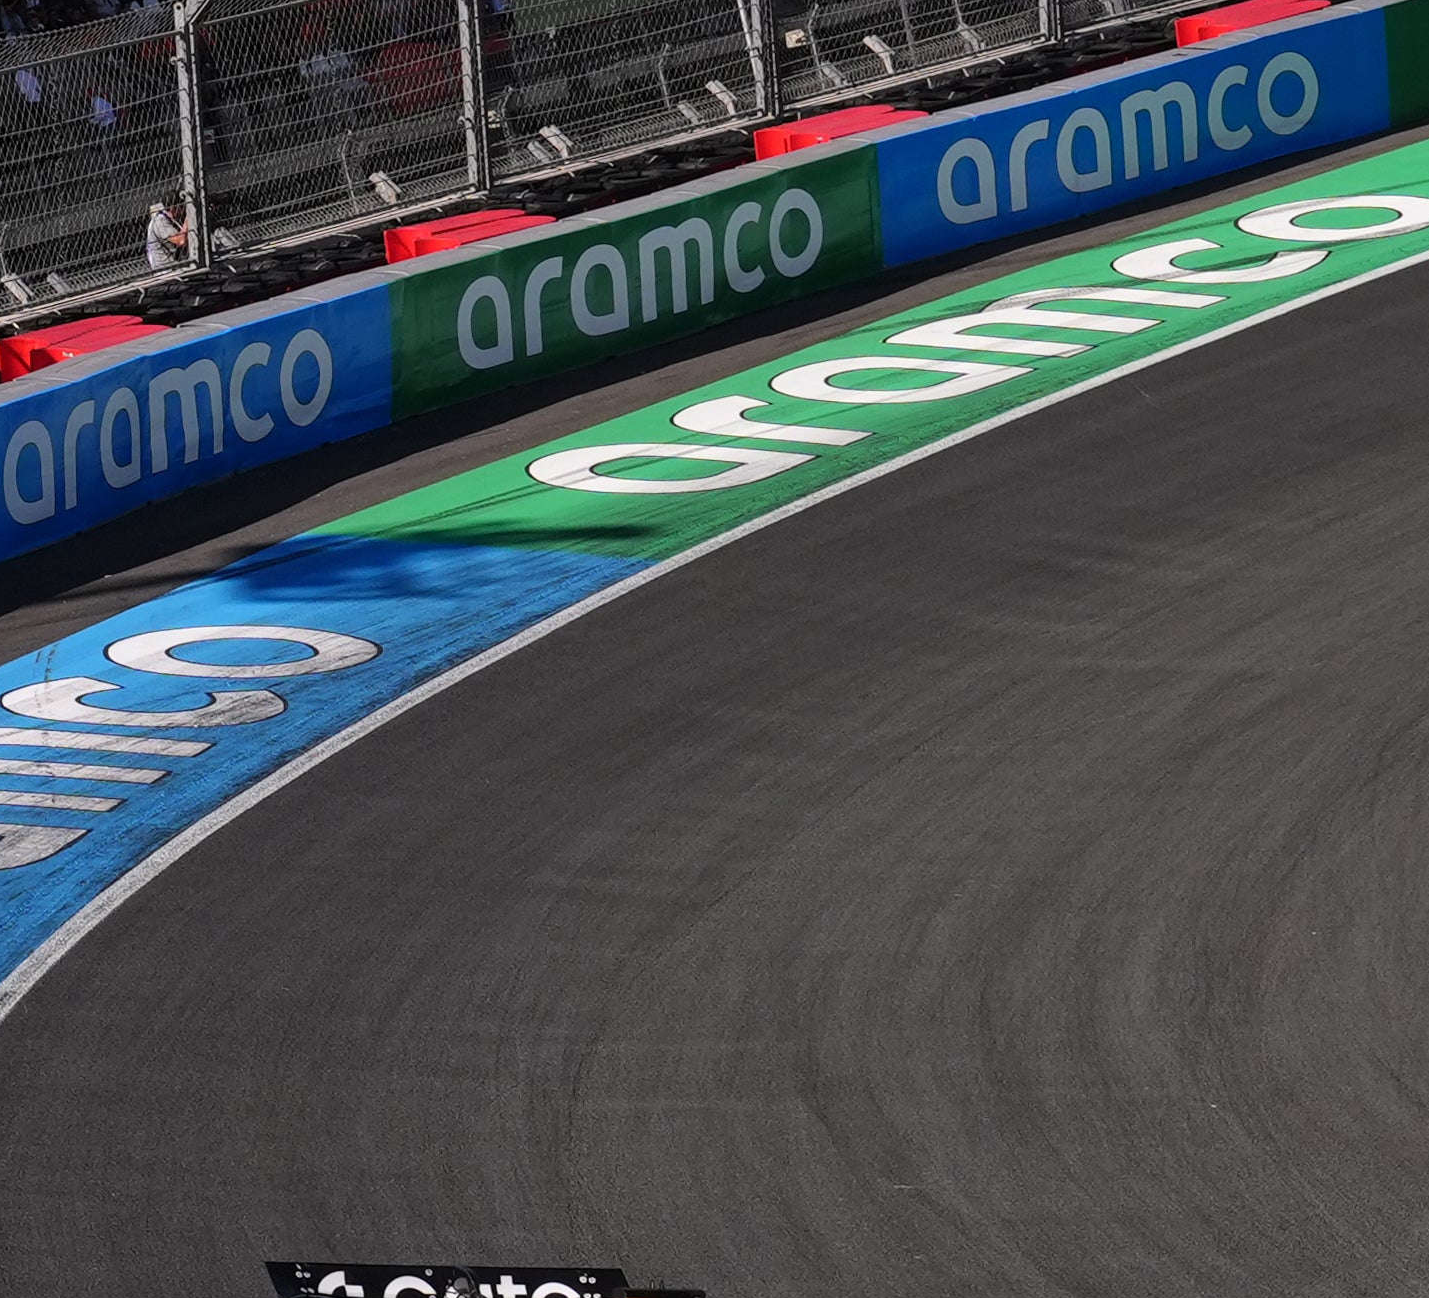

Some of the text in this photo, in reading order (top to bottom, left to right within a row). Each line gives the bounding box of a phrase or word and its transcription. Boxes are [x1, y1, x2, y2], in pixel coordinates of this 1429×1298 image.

[938, 53, 1319, 224] aramco
[457, 189, 824, 369] aramco
[3, 329, 333, 525] aramco
